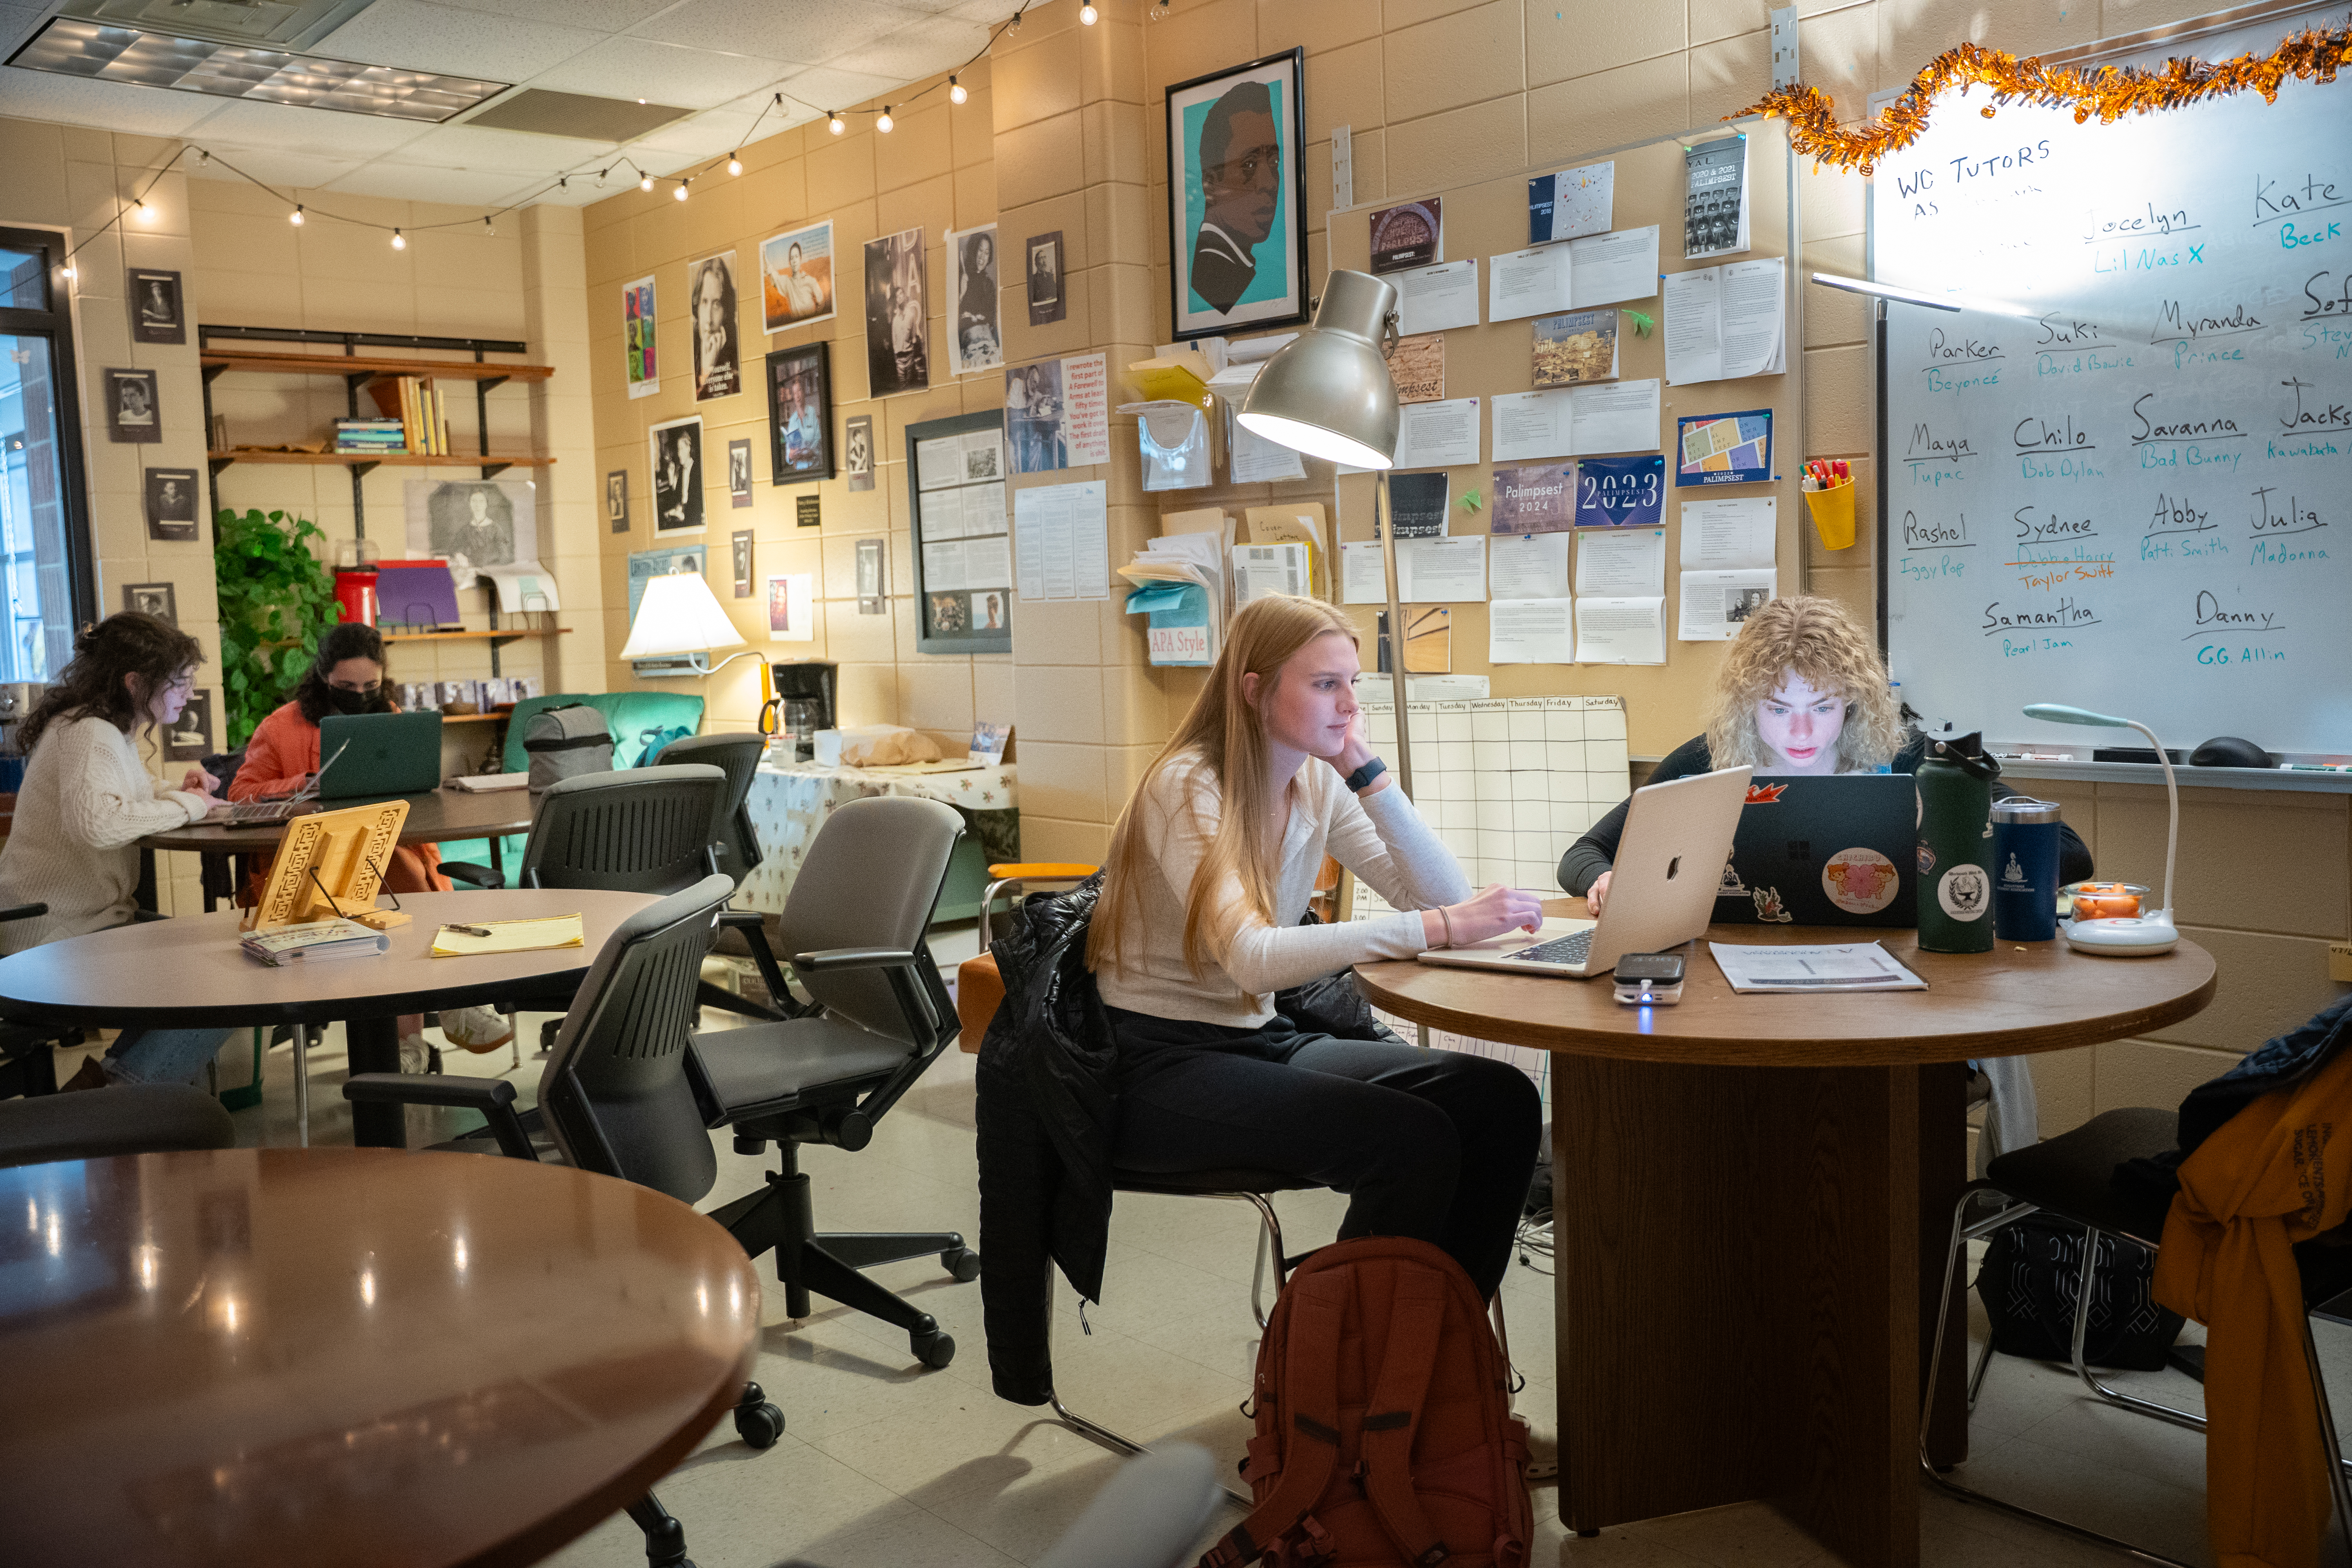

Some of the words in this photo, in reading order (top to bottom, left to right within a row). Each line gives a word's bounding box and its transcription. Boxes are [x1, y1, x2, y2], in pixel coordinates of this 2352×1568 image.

[1691, 174, 1736, 188] PALIMPSEST
[1692, 170, 1708, 179] 2020
[1719, 165, 1736, 174] 2021
[1897, 170, 1934, 200] WC
[1950, 140, 2050, 184] TUTORS
[1530, 201, 1553, 210] ALIMPSEST
[2256, 173, 2340, 219] Kate
[1913, 200, 1939, 221] AS
[2083, 201, 2187, 240] Jocelyn
[2280, 222, 2341, 249] Beck
[2095, 249, 2127, 273] Lil
[2136, 248, 2179, 270] Nas
[2189, 243, 2204, 265] X
[1553, 314, 1594, 330] PALIMPSEST
[2038, 312, 2098, 345] Suki
[2152, 299, 2260, 339] Myranda
[1930, 327, 2000, 361] Parker
[2174, 342, 2245, 367] Prince
[724, 371, 733, 380] else
[1069, 360, 1093, 370] rewrote
[1084, 371, 1097, 379] part
[2039, 355, 2082, 377] David
[2088, 355, 2135, 371] Bowie
[1074, 380, 1098, 389] Farewell
[1075, 401, 1087, 410] fifty
[2131, 394, 2238, 441] Savanna
[1909, 423, 1970, 461] Maya
[2014, 415, 2086, 449] Chilo
[1082, 440, 1106, 448] anything
[2267, 440, 2338, 459] Kawabata
[2023, 457, 2056, 479] Bob
[2061, 458, 2104, 479] Dylan
[2141, 443, 2178, 469] Bad
[2186, 445, 2241, 473] Bunny
[1704, 474, 1744, 483] PALIMPSEST
[1909, 463, 1964, 486] Tupac
[1506, 483, 1563, 500] Palimpsest
[1582, 474, 1658, 509] 2023
[1520, 501, 1548, 512] 2024
[2150, 493, 2208, 529] Abby
[2250, 486, 2320, 530] Julia
[2016, 506, 2092, 544] Sydnee
[2141, 537, 2174, 561] Patti
[2181, 539, 2229, 557] Smith
[2250, 543, 2330, 566] Madonna
[1900, 557, 1937, 580] Iggy
[1942, 555, 1965, 577] Pop
[2018, 571, 2069, 592] Taylor
[2074, 564, 2114, 580] Swift
[1983, 597, 2094, 627] Samantha
[2196, 590, 2274, 628] Danny
[1152, 632, 1174, 652] APA
[1177, 630, 1205, 658] Style
[2003, 639, 2036, 657] Pearl
[2043, 637, 2073, 651] Jam
[2241, 647, 2285, 662] Allin
[1471, 701, 1505, 709] Wednesday
[1509, 700, 1542, 709] Thursday
[1547, 699, 1571, 708] Friday
[1586, 699, 1618, 707] Saturday
[1724, 871, 1737, 881] ASA
